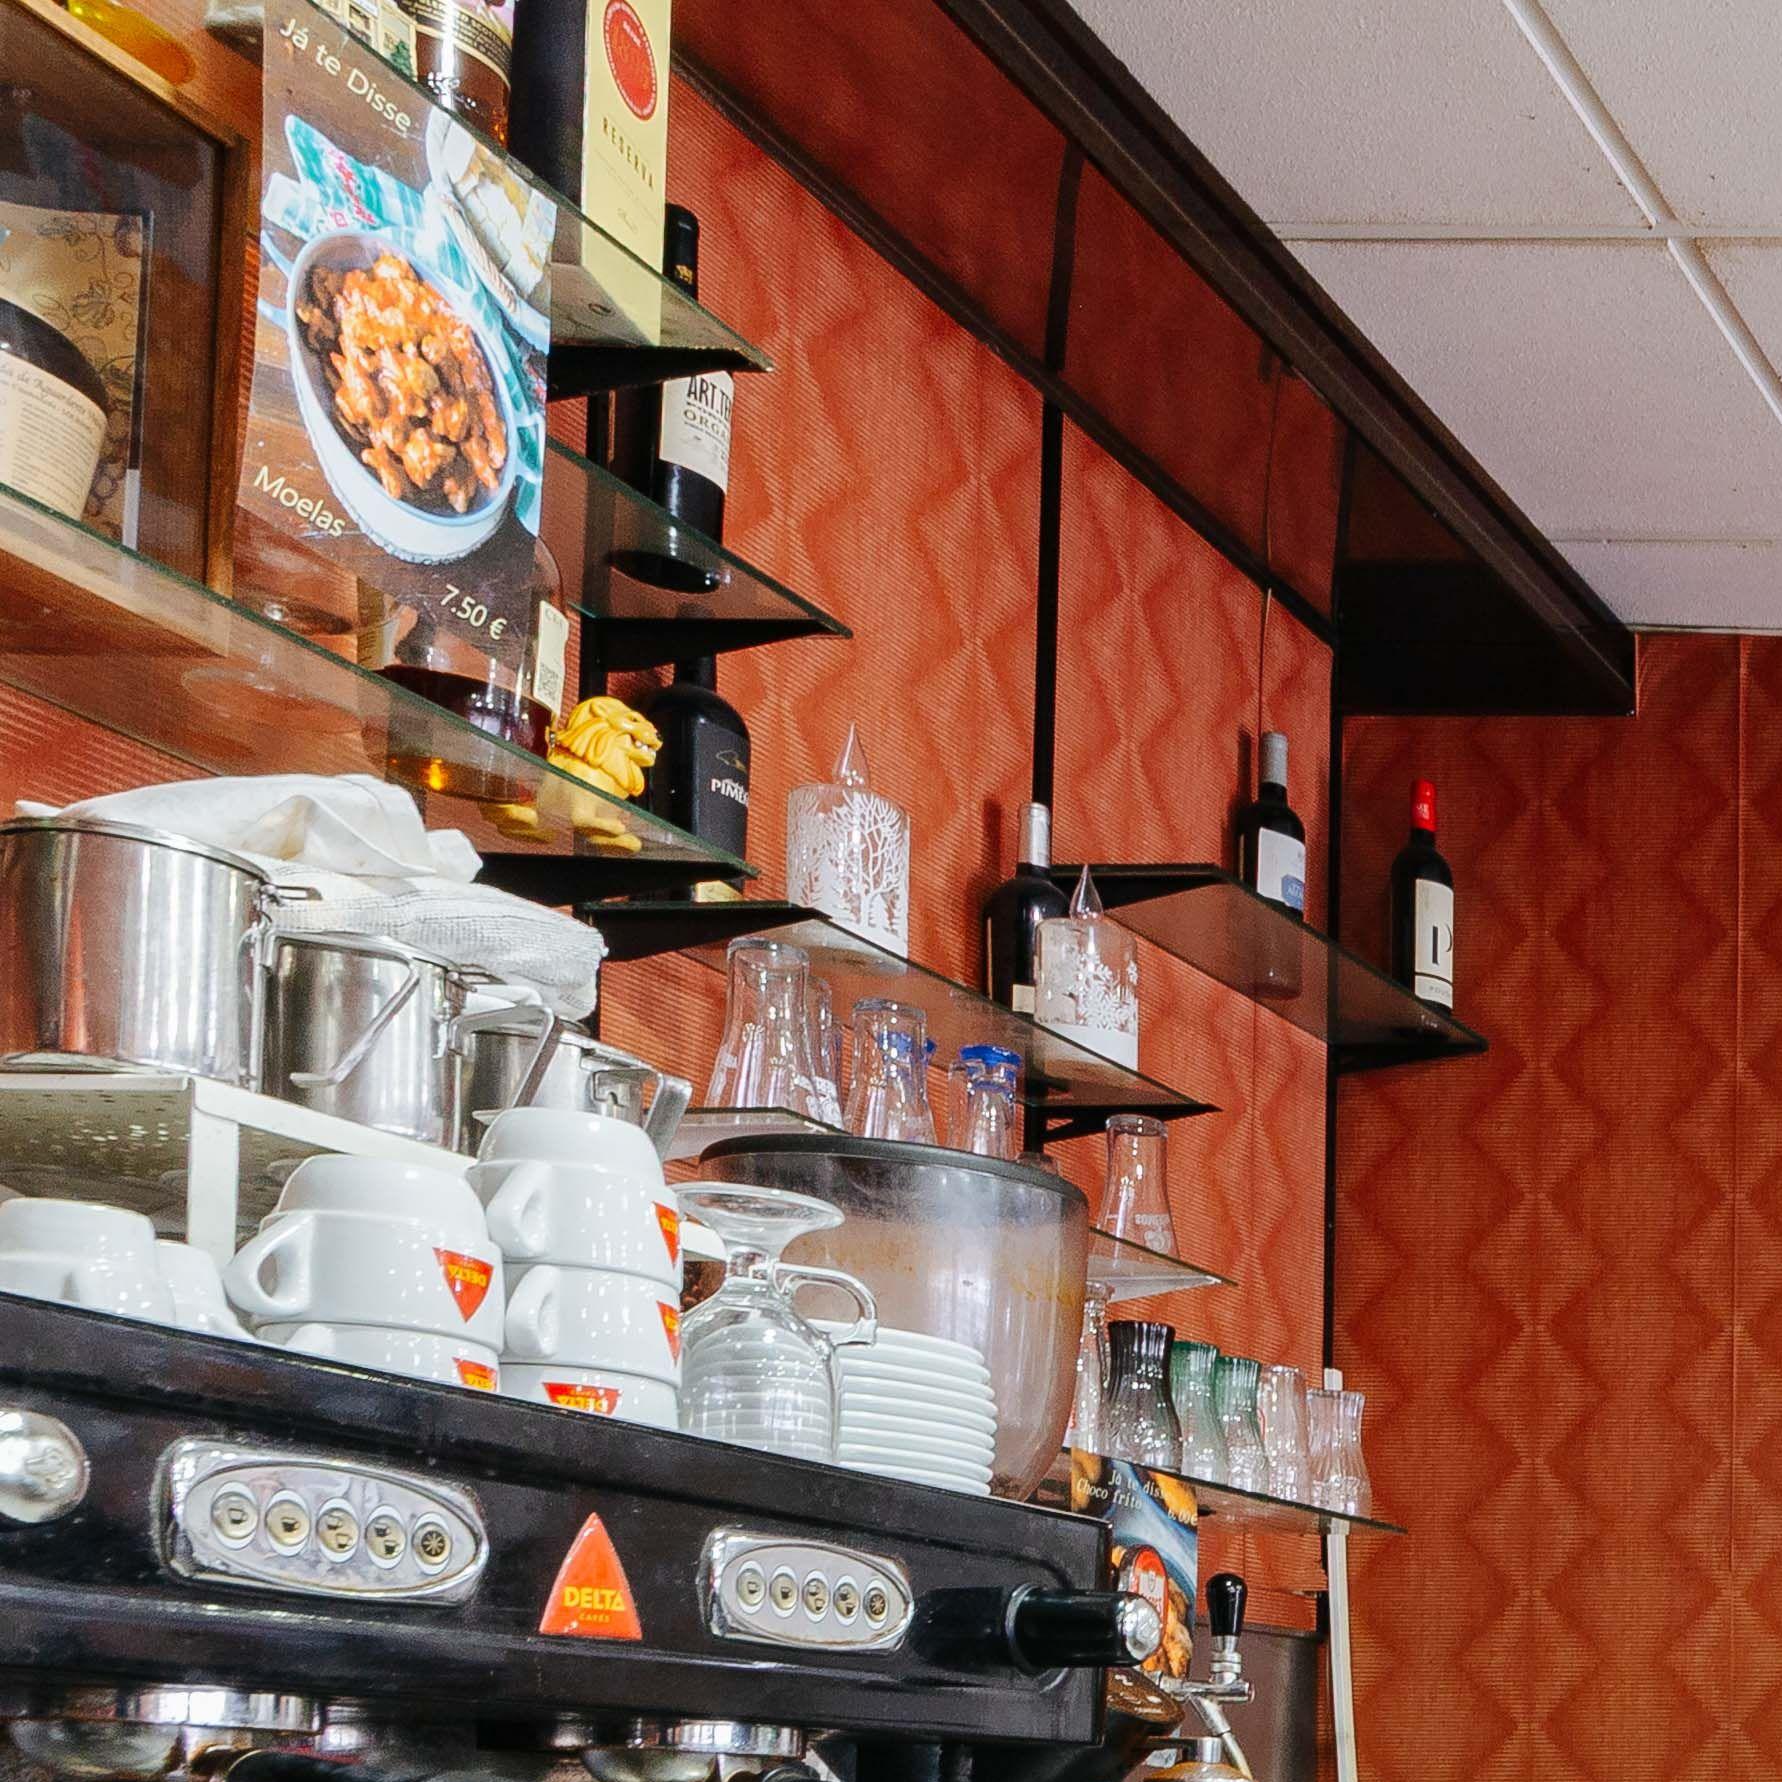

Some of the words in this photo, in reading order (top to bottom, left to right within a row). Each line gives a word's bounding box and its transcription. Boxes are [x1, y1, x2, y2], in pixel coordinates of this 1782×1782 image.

[280, 18, 309, 51] Já
[315, 44, 341, 77] te
[346, 68, 412, 138] Disse
[601, 116, 655, 190] RESERVA
[253, 465, 346, 537] Moelas
[440, 584, 488, 627] 7.50
[488, 618, 508, 641] €
[447, 1263, 488, 1289] DELTA
[1076, 1477, 1109, 1500] Choco
[1112, 1487, 1144, 1511] frito
[563, 1585, 626, 1612] DELTA
